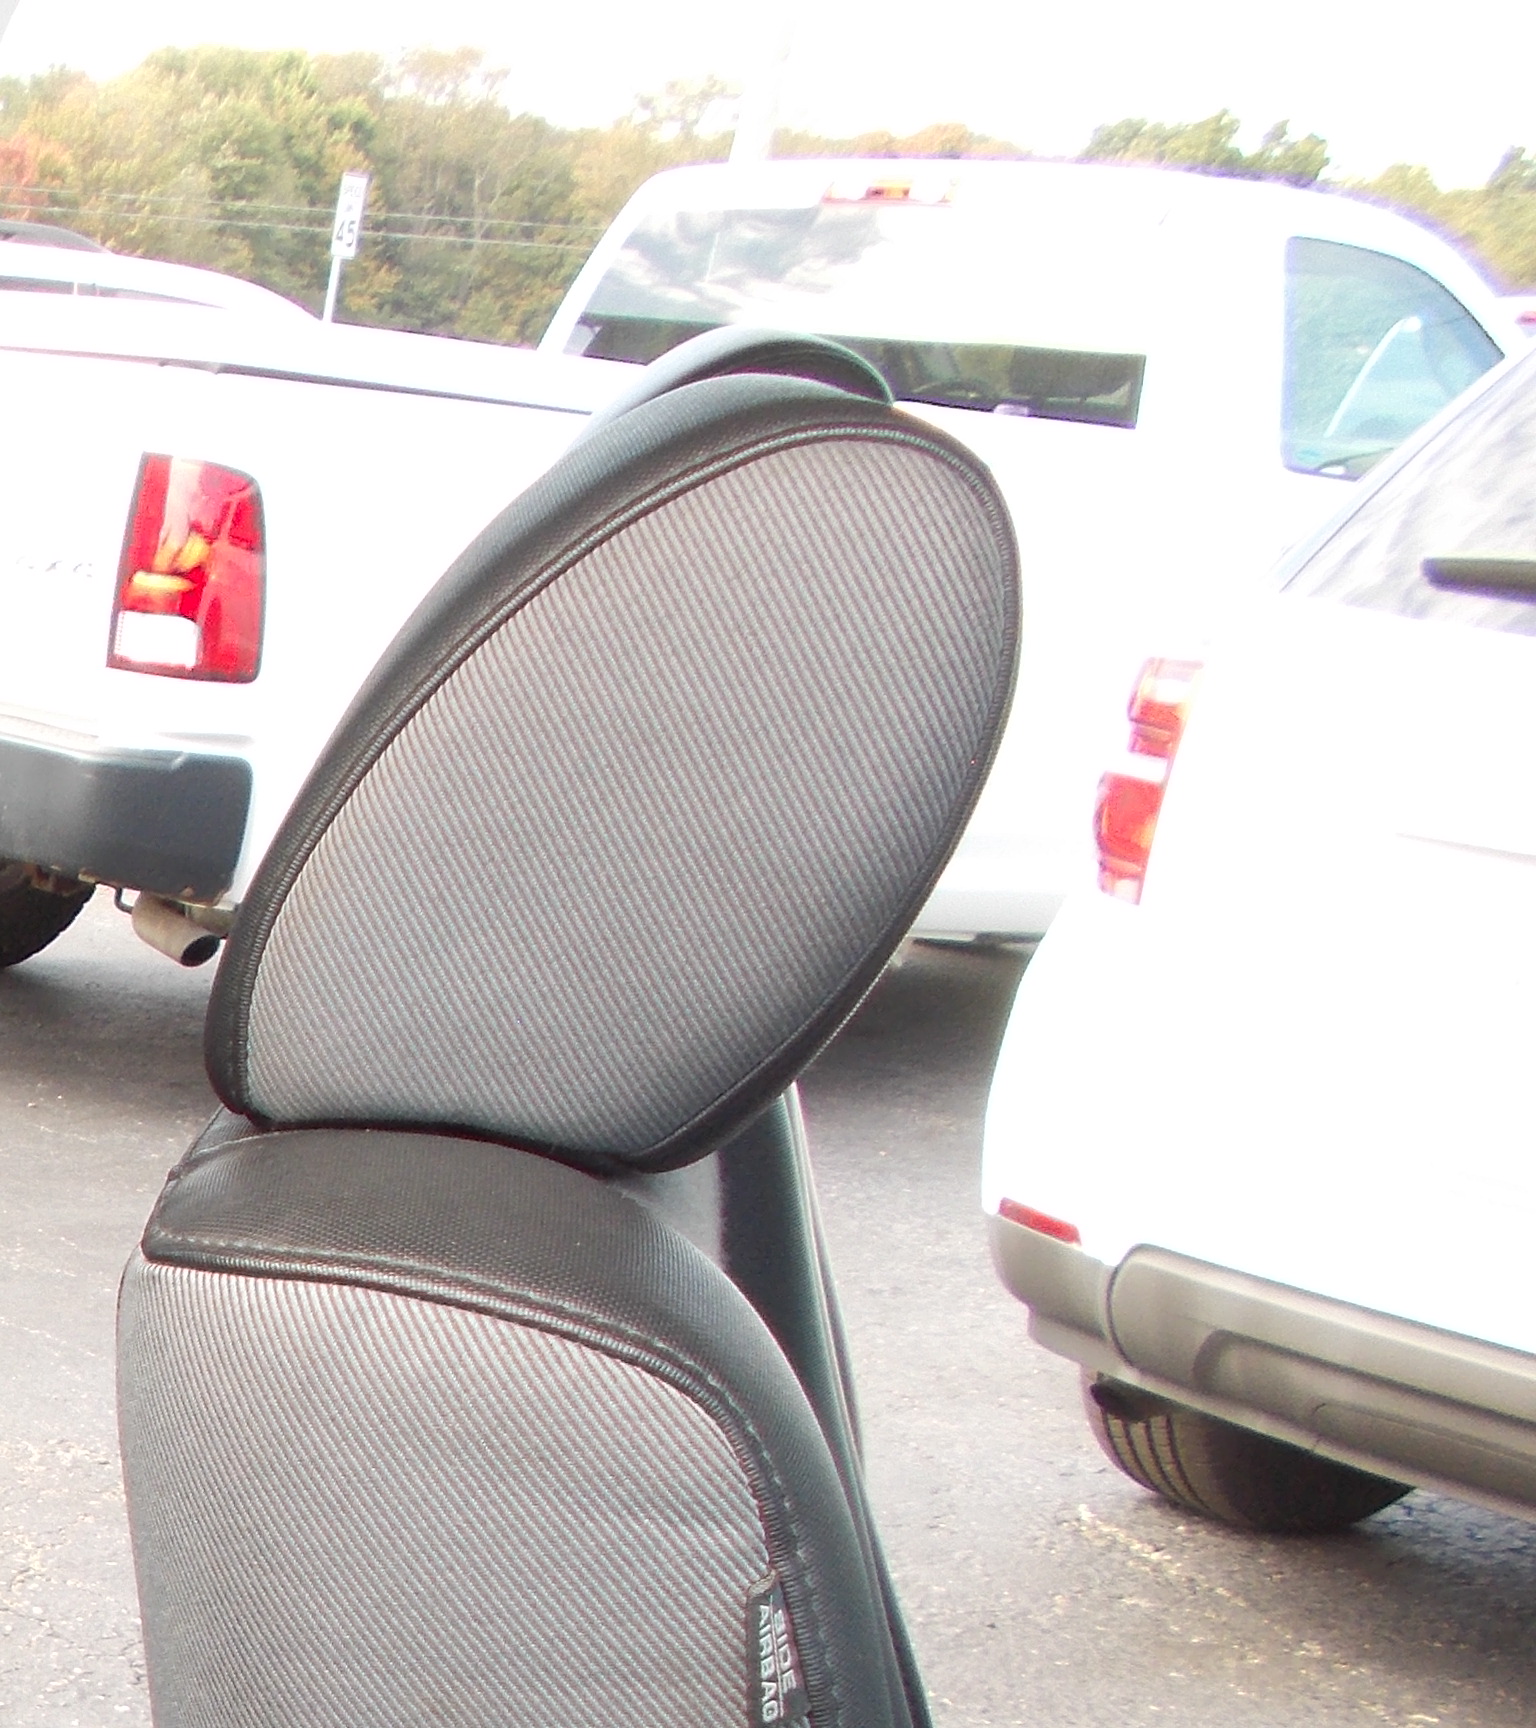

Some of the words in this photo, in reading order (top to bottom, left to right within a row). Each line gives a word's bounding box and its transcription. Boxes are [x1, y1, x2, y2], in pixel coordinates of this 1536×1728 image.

[335, 219, 356, 247] 45
[759, 1604, 779, 1723] AIRBAG
[774, 1609, 797, 1694] SIDE
